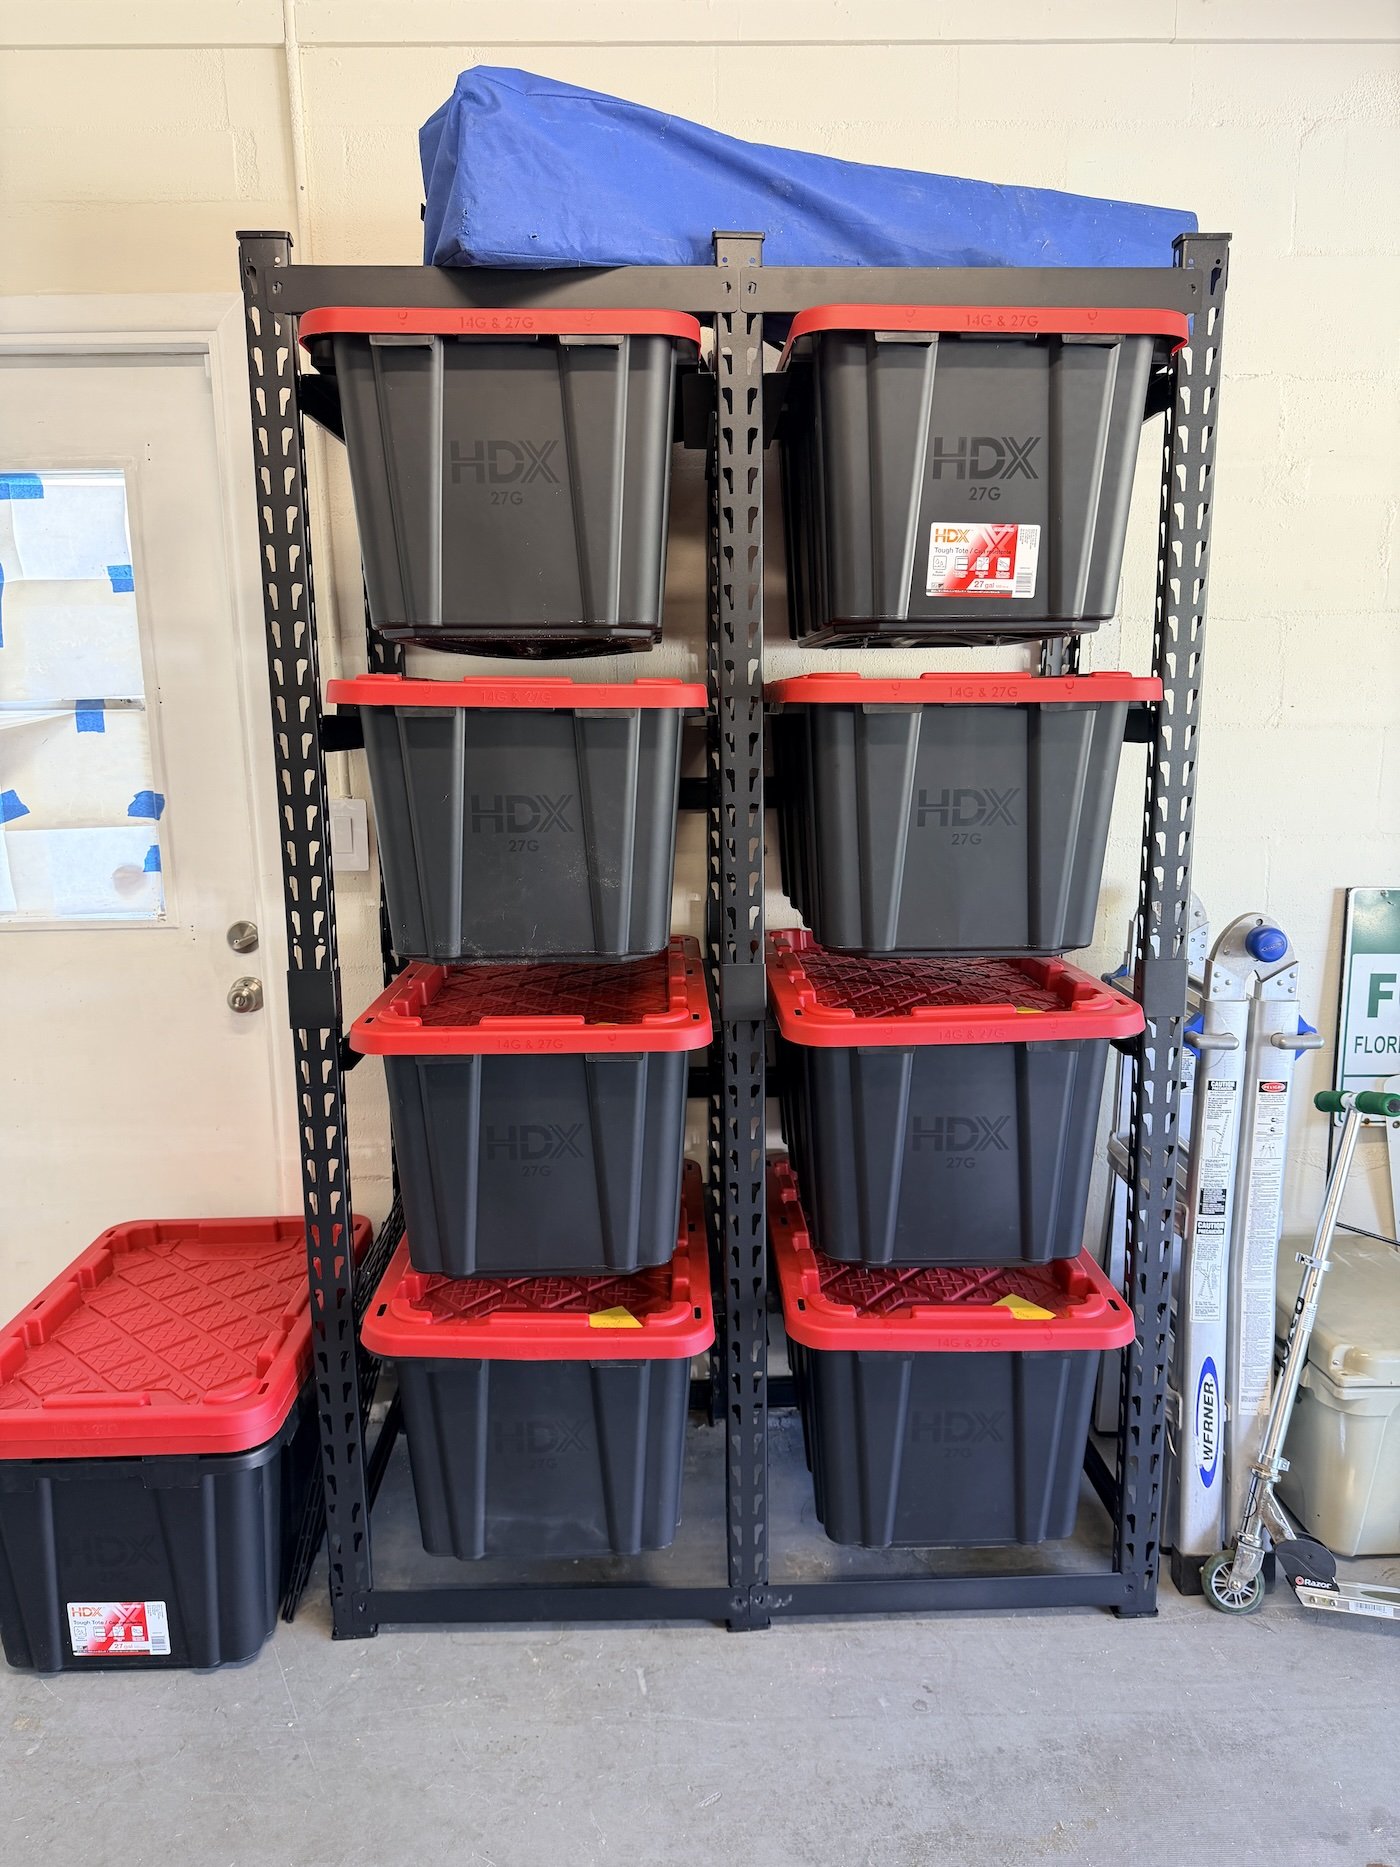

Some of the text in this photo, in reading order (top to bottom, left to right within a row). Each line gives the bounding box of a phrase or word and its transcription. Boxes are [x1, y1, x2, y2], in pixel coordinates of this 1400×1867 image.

[459, 316, 534, 329] 14G & 27G
[965, 314, 1039, 328] 14G & 27G
[450, 440, 560, 484] HDX
[932, 437, 1041, 480] HDX
[490, 491, 523, 506] 27G
[969, 487, 1001, 501] 27G
[934, 528, 970, 543] HDX
[934, 547, 953, 555] Tough
[948, 686, 1018, 698] 14G & 27G
[471, 794, 576, 833] HDX
[917, 788, 1021, 828] HDX
[508, 839, 539, 852] 27G
[951, 833, 982, 846] 27G
[1367, 973, 1400, 1018] F
[497, 1038, 563, 1050] 14G & 27G
[911, 1115, 1011, 1151] HDX
[486, 1123, 585, 1161] HDX
[946, 1157, 976, 1169] 27G
[522, 1165, 552, 1177] 27G
[1198, 1221, 1224, 1229] CAUTION
[937, 1337, 1001, 1348] 14G & 27G
[911, 1410, 1005, 1443] HDX
[494, 1418, 590, 1452] HDX
[1304, 1579, 1332, 1589] Razor
[71, 1607, 102, 1617] HDX
